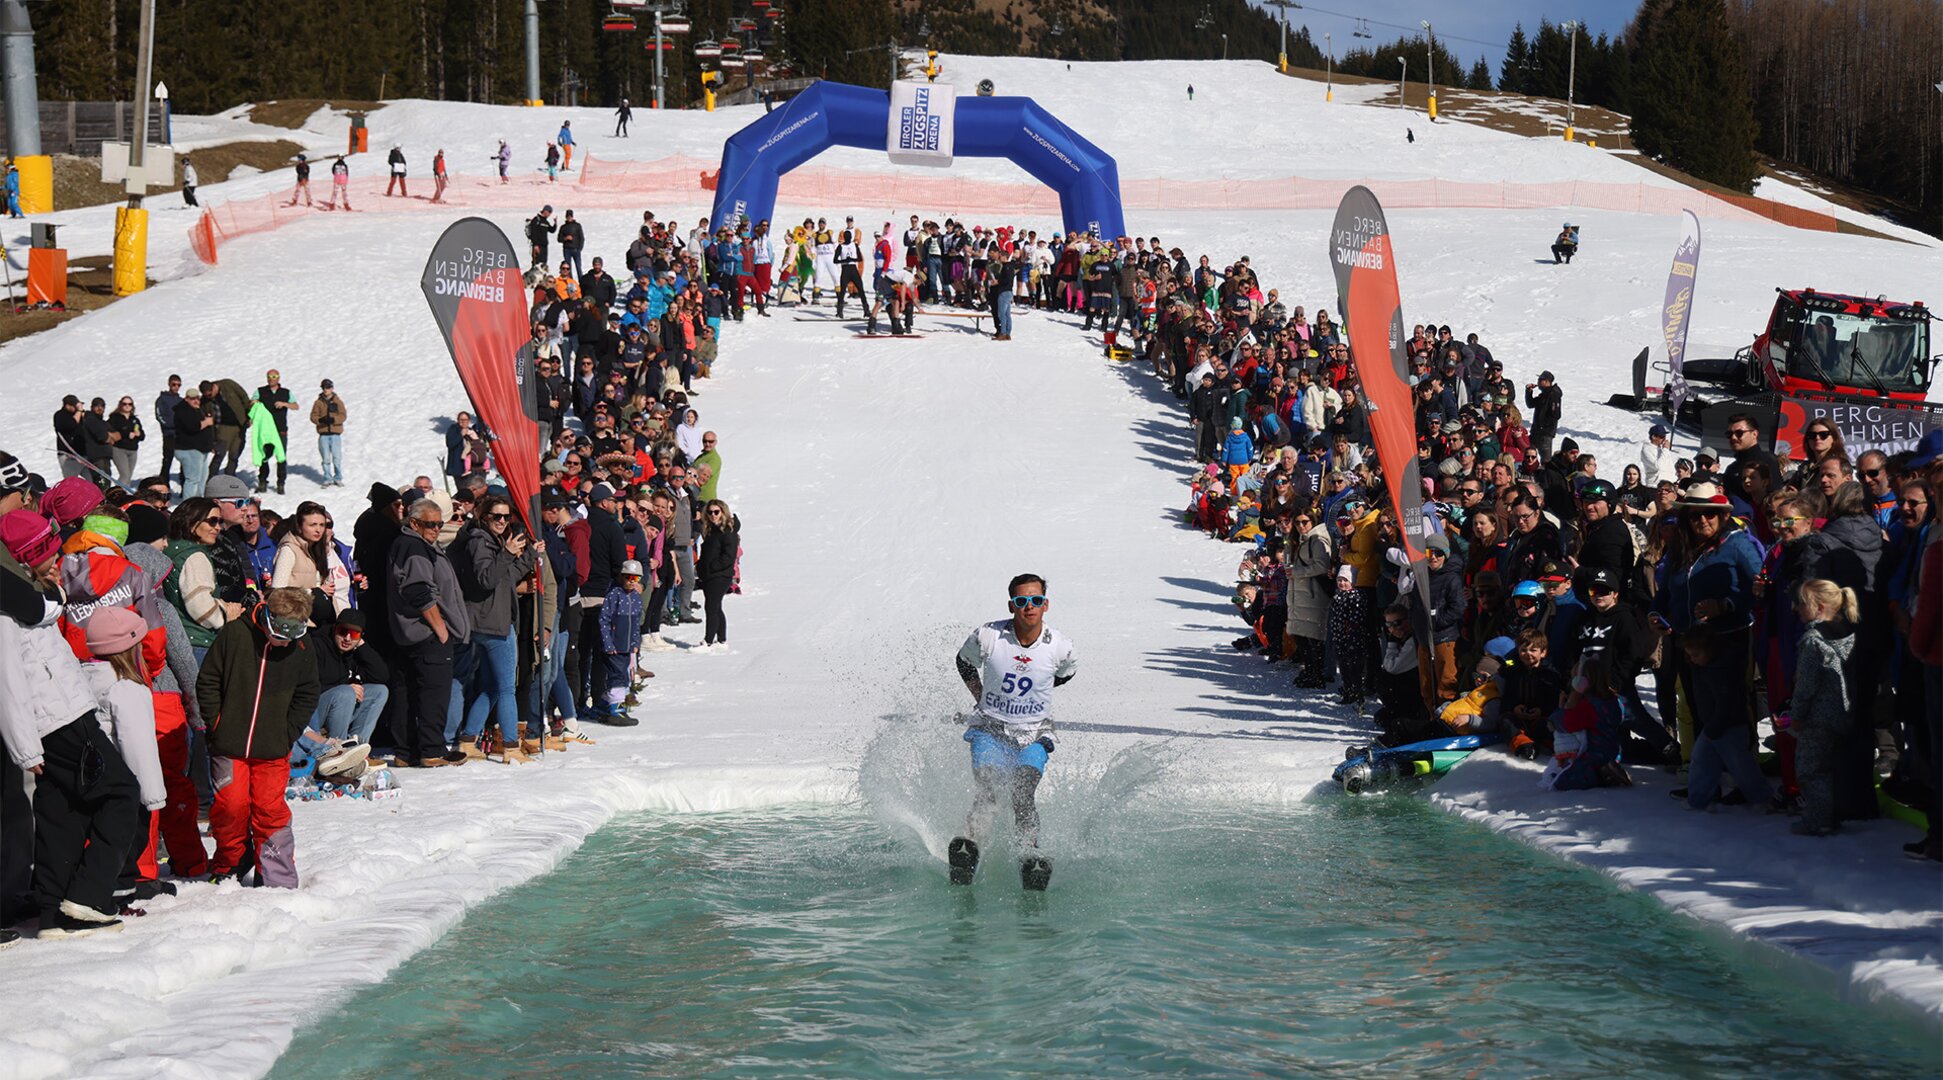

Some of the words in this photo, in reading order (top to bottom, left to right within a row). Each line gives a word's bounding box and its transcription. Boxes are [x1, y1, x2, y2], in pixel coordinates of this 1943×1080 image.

[902, 108, 912, 148] TIROLER
[914, 89, 928, 149] ZUGSPITZ
[929, 117, 938, 150] ARENA
[1837, 422, 1924, 442] AHNEN
[1001, 672, 1033, 697] 59
[985, 691, 1045, 715] Edelweiss
